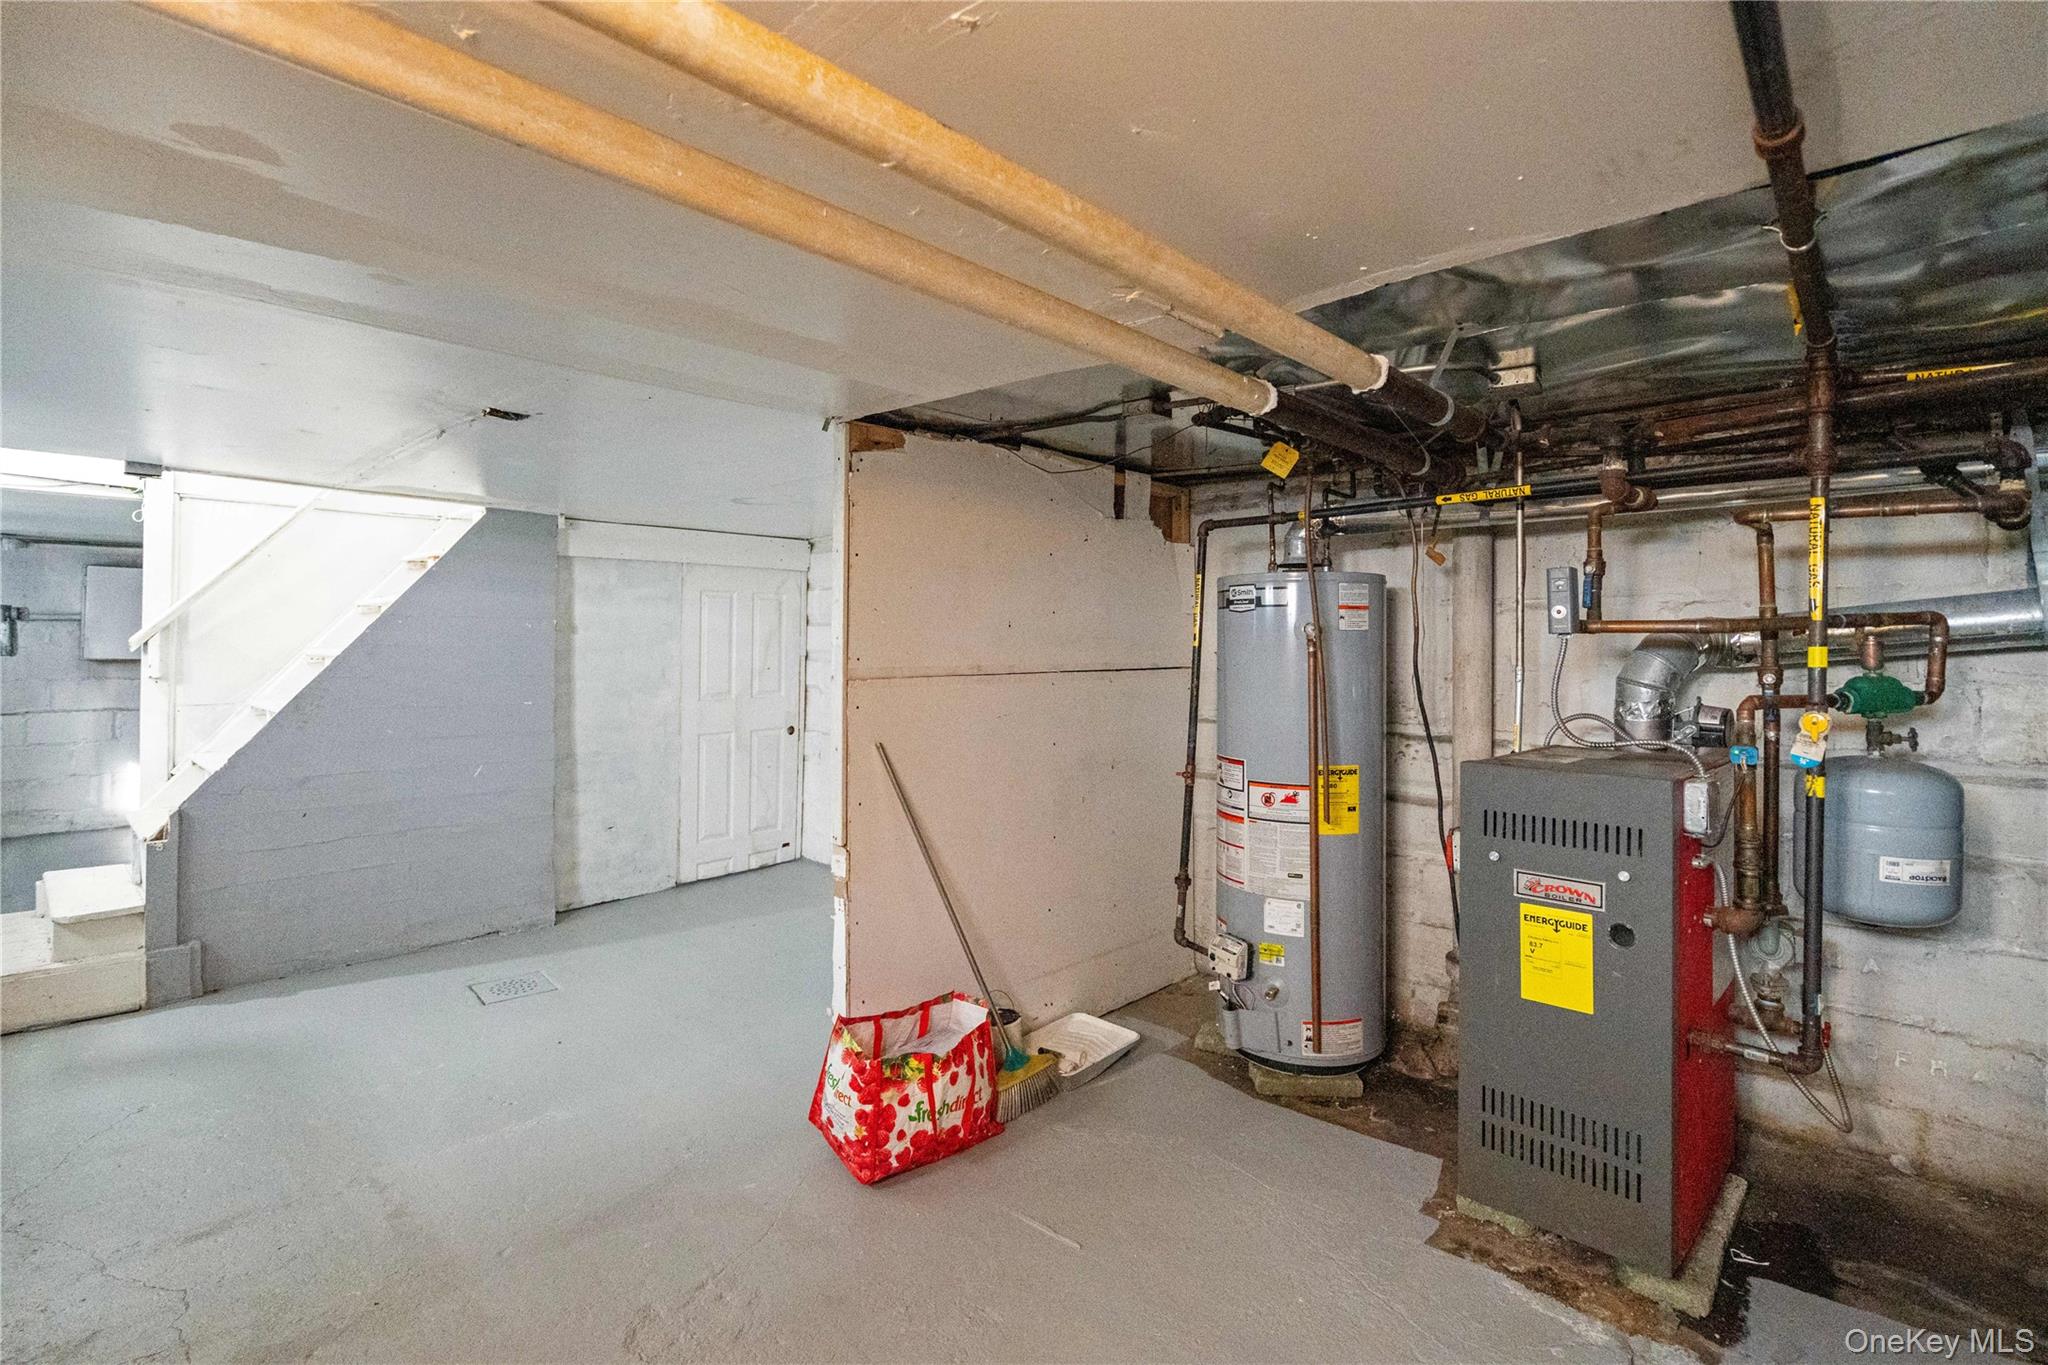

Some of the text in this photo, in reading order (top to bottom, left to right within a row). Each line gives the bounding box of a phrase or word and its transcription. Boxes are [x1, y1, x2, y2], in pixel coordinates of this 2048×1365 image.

[1459, 487, 1526, 502] NATURAL GAS
[1808, 503, 1823, 588] NATURAL GAS
[1530, 879, 1597, 904] CROWN
[1544, 893, 1583, 903] BOILER
